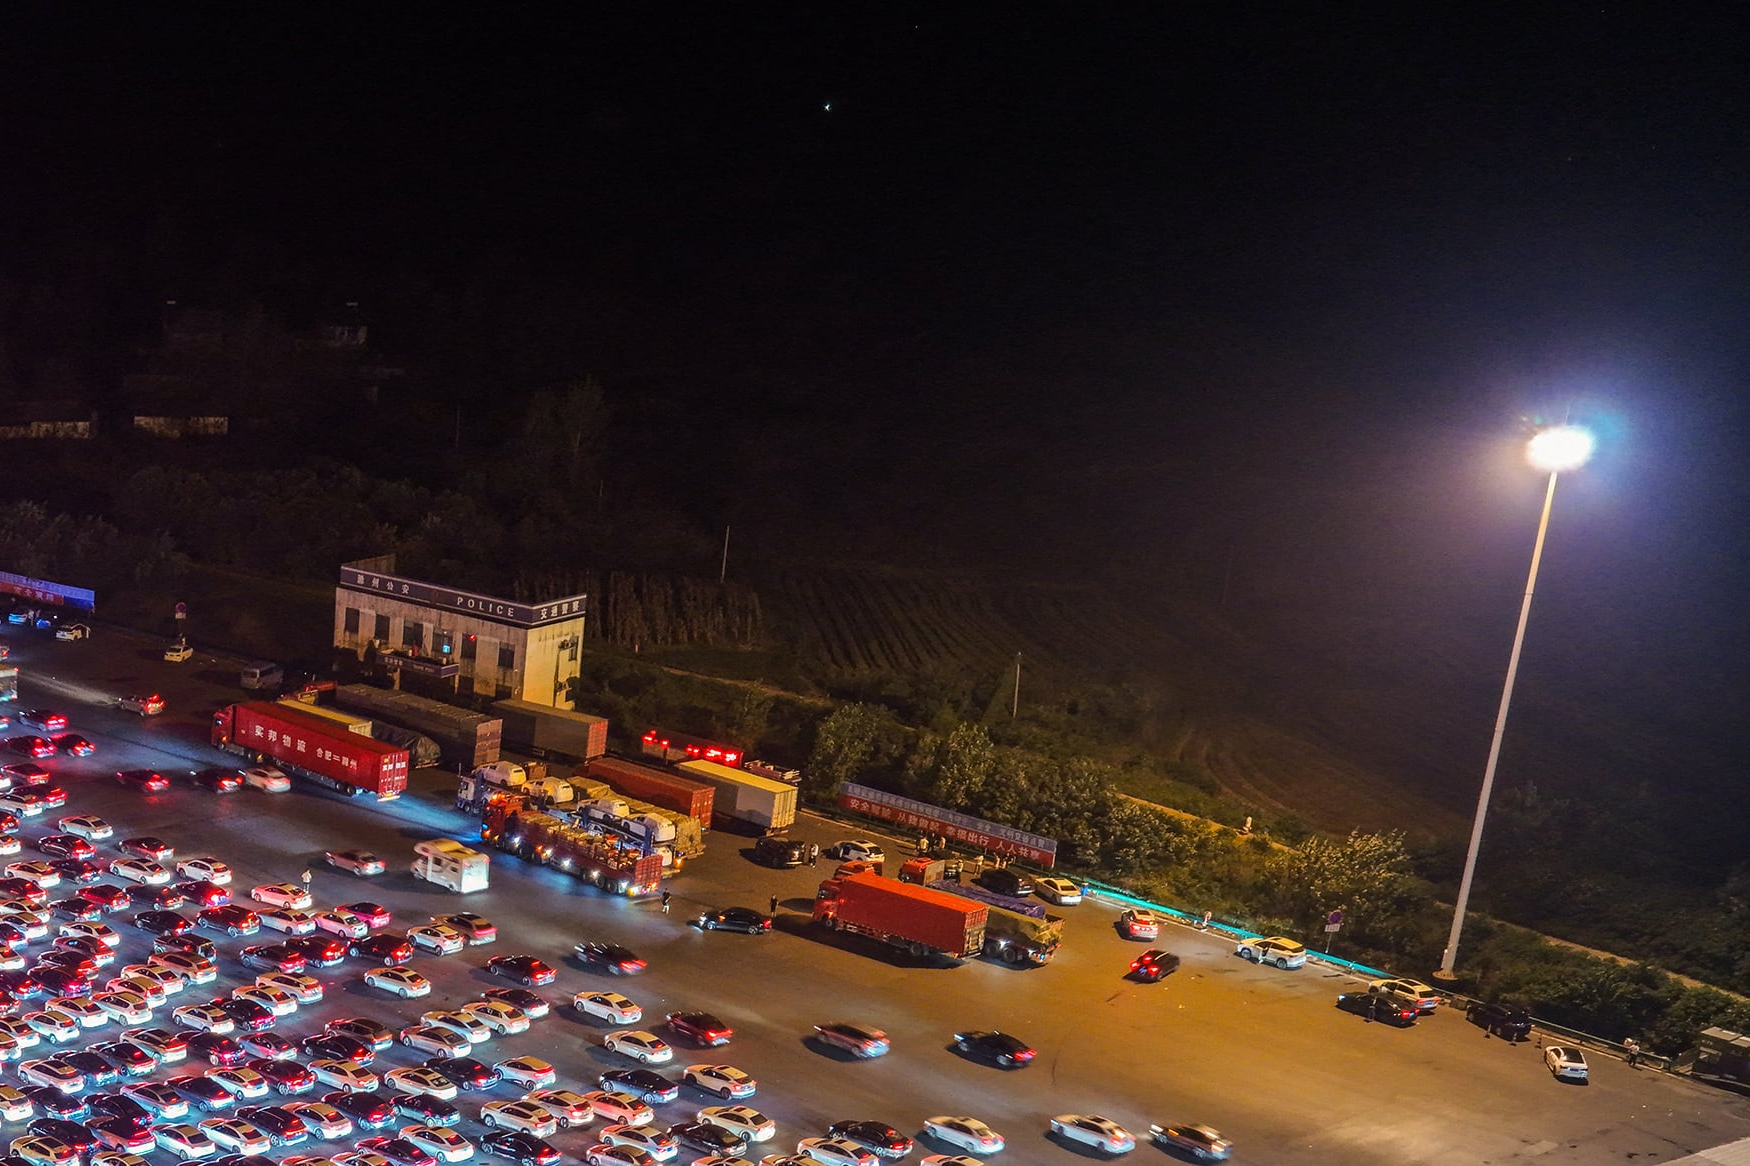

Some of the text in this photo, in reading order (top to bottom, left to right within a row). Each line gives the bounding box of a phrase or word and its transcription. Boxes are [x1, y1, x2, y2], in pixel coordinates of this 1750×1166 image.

[357, 574, 410, 595] 滁州公安
[457, 596, 515, 617] POLICE
[540, 600, 580, 620] 交通警察
